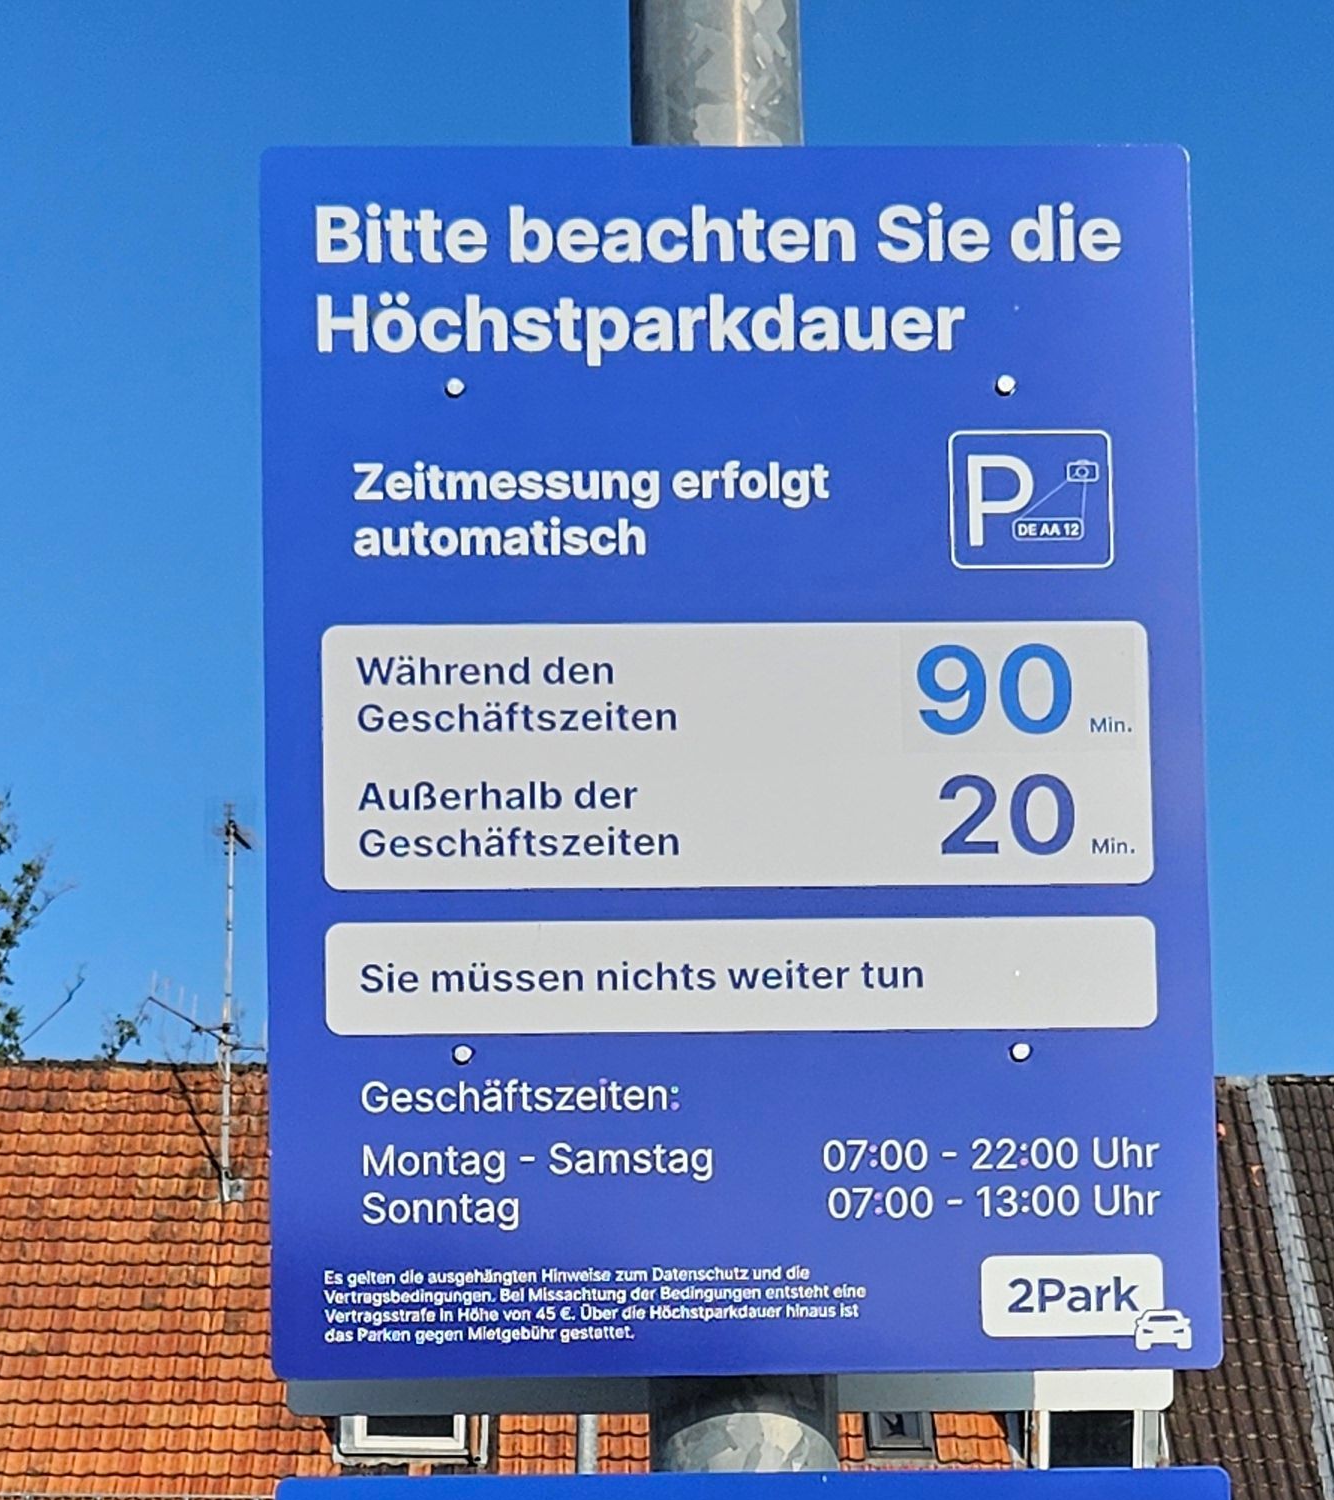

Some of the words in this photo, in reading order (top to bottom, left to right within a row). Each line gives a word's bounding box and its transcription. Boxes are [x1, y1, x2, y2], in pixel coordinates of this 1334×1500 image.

[316, 203, 487, 263] Bitte
[510, 205, 855, 263] beachten
[878, 202, 989, 262] Sie
[1011, 202, 1121, 262] die
[317, 292, 965, 366] Höchstparkdauer
[354, 461, 659, 508] Zeitmessung
[673, 461, 829, 508] erfolgt
[967, 454, 1034, 547] P
[354, 517, 645, 556] automatisch
[1018, 524, 1037, 536] DE
[1040, 524, 1061, 536] AA
[1064, 523, 1080, 536] 12
[356, 656, 529, 685] Während
[543, 657, 613, 684] den
[917, 644, 1072, 735] 90
[358, 702, 676, 732] Geschäftszeiten
[1091, 717, 1131, 732] Min.
[359, 781, 562, 810] Außerhalb
[575, 781, 637, 809] der
[939, 774, 1074, 855] 20
[360, 826, 679, 857] Geschäftszeiten
[1092, 838, 1134, 854] Min.
[361, 963, 418, 993] Sie
[433, 963, 583, 992] müssen
[597, 961, 716, 990] nichts
[728, 960, 849, 989] weiter
[861, 962, 923, 989] tun
[362, 1079, 679, 1112] Geschäftszeiten:
[364, 1145, 505, 1183] Montag
[550, 1143, 712, 1180] Samstag
[824, 1139, 927, 1172] 07:00
[972, 1138, 1078, 1169] 22:00
[1092, 1137, 1159, 1169] Uhr
[363, 1193, 518, 1230] Sonntag
[829, 1187, 933, 1218] 07:00
[977, 1185, 1079, 1216] 13:00
[1095, 1185, 1160, 1218] Uhr
[325, 1271, 343, 1284] Es
[347, 1271, 395, 1287] gelten
[400, 1269, 423, 1284] die
[428, 1269, 536, 1288] ausgehängten
[542, 1268, 611, 1284] Hinweise
[613, 1271, 650, 1281] zum
[653, 1265, 750, 1284] Datenschutz
[753, 1266, 781, 1279] und
[784, 1265, 810, 1281] die
[324, 1289, 496, 1306] Vertragsbedingungen.
[500, 1287, 524, 1302] Bei
[527, 1283, 628, 1306] Missachtung
[628, 1287, 656, 1303] der
[659, 1286, 763, 1305] Bedingungen
[766, 1285, 829, 1299] entsteht
[832, 1284, 866, 1300] eine
[1008, 1276, 1141, 1315] 2Park
[325, 1307, 436, 1326] Vertragsstrafe
[440, 1308, 453, 1321] in
[458, 1307, 499, 1321] Höhe
[503, 1310, 531, 1321] von
[536, 1306, 556, 1320] 45
[560, 1306, 575, 1320] €.
[580, 1304, 618, 1320] Über
[622, 1305, 646, 1320] die
[650, 1305, 782, 1321] Höchstparkdauer
[785, 1304, 836, 1317] hinaus
[839, 1303, 858, 1317] ist
[325, 1328, 353, 1342] das
[358, 1328, 410, 1342] Parken
[415, 1330, 463, 1344] gegen
[468, 1326, 557, 1343] Mietgebühr
[560, 1326, 634, 1342] gestattet.
